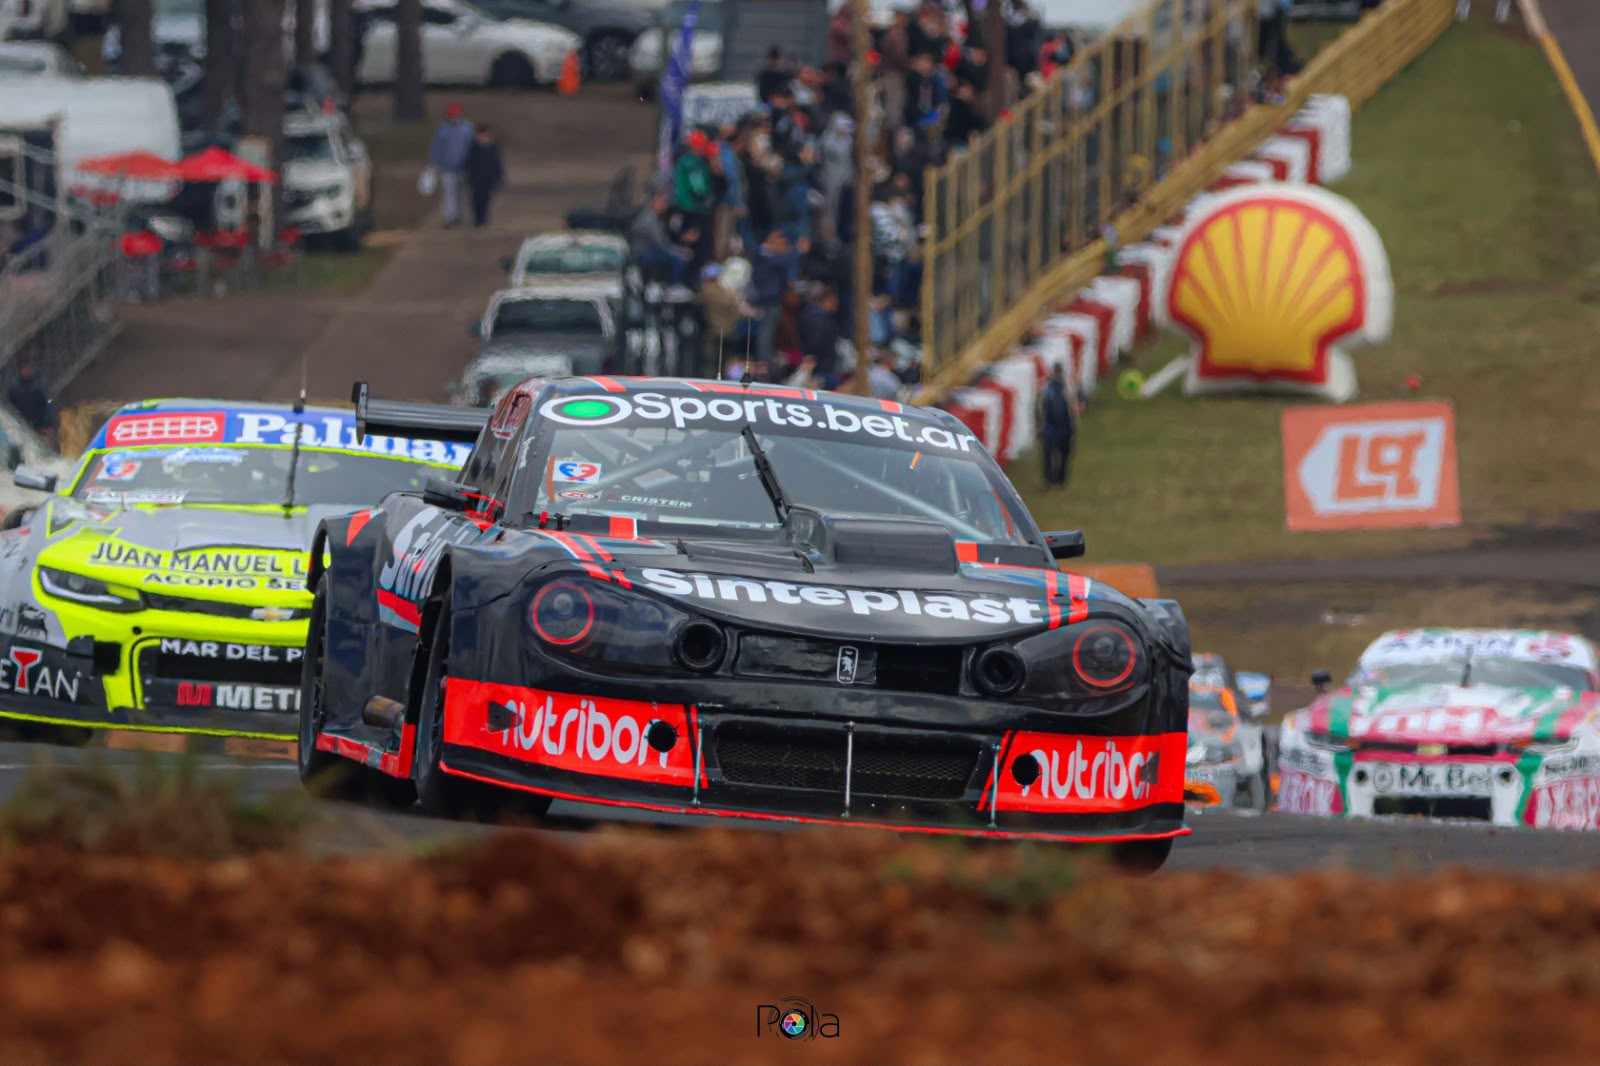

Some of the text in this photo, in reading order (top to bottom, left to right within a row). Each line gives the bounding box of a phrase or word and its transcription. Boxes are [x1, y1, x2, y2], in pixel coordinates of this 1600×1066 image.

[632, 392, 976, 451] Sports.bet.ar
[621, 494, 693, 508] CRISTEM
[90, 542, 162, 567] JUAN
[170, 551, 283, 573] MANUEL
[144, 572, 308, 591] ACOPIO SE
[642, 568, 1044, 625] Sinteplast
[161, 638, 219, 658] MAR
[225, 643, 279, 662] DEL
